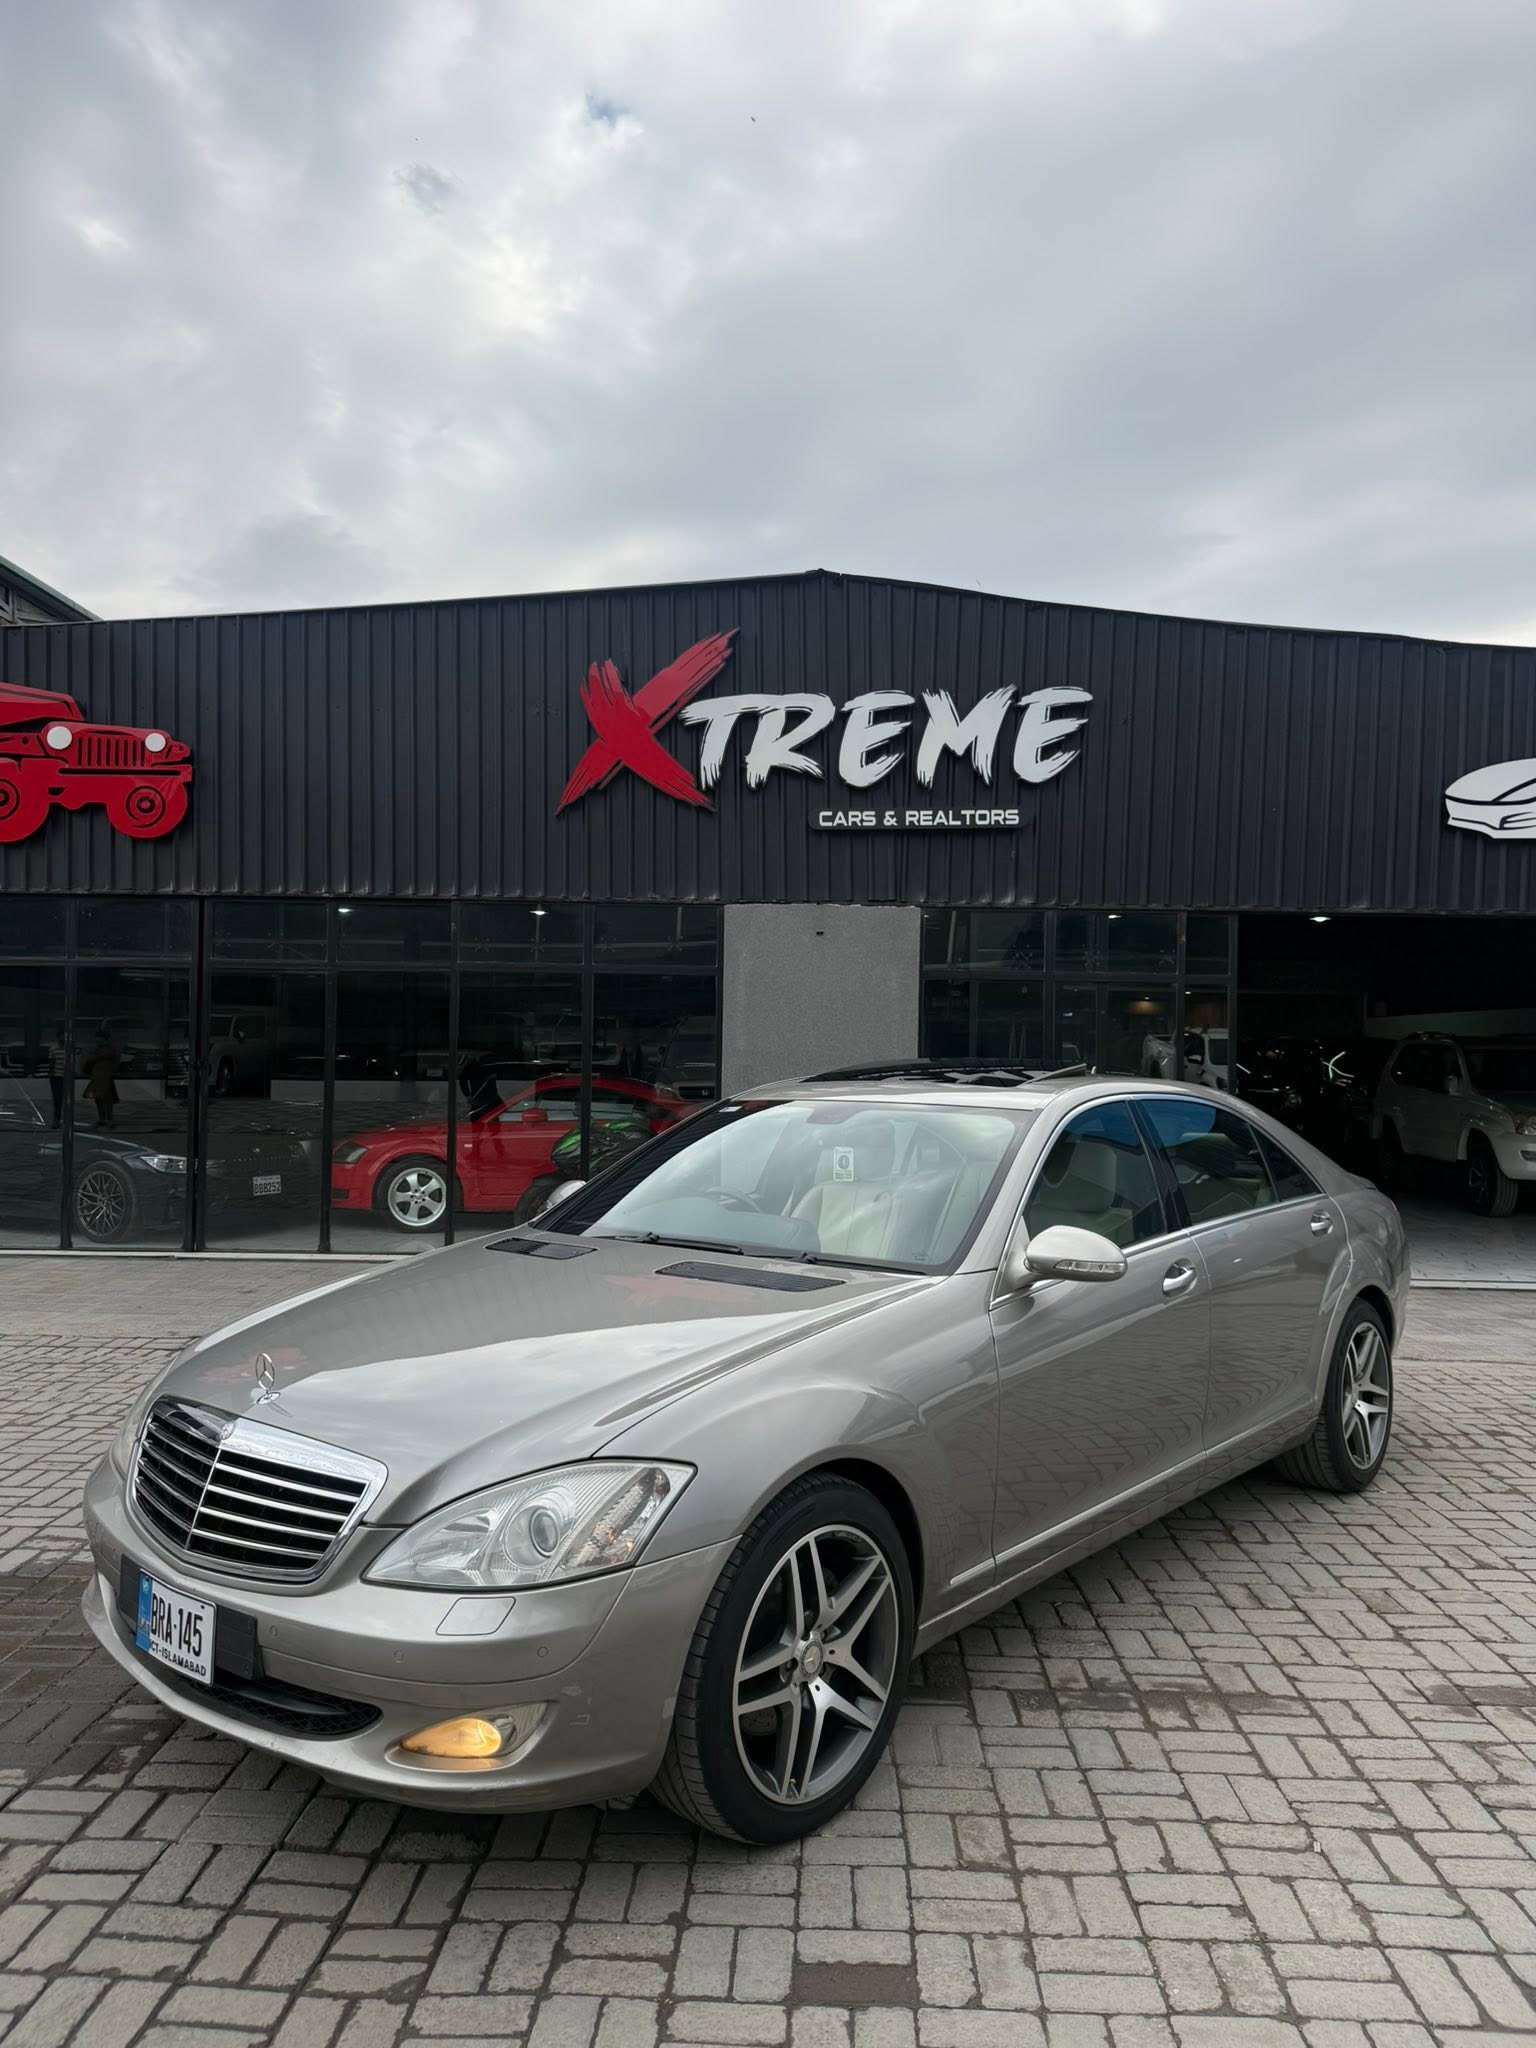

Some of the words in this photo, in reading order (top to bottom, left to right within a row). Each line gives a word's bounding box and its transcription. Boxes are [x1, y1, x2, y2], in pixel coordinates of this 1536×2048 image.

[555, 628, 1094, 815] XTREME
[819, 811, 876, 826] CARS
[883, 810, 898, 826] &
[905, 809, 1020, 826] REALTORS
[151, 1642, 207, 1677] CT-ISLAMABAD
